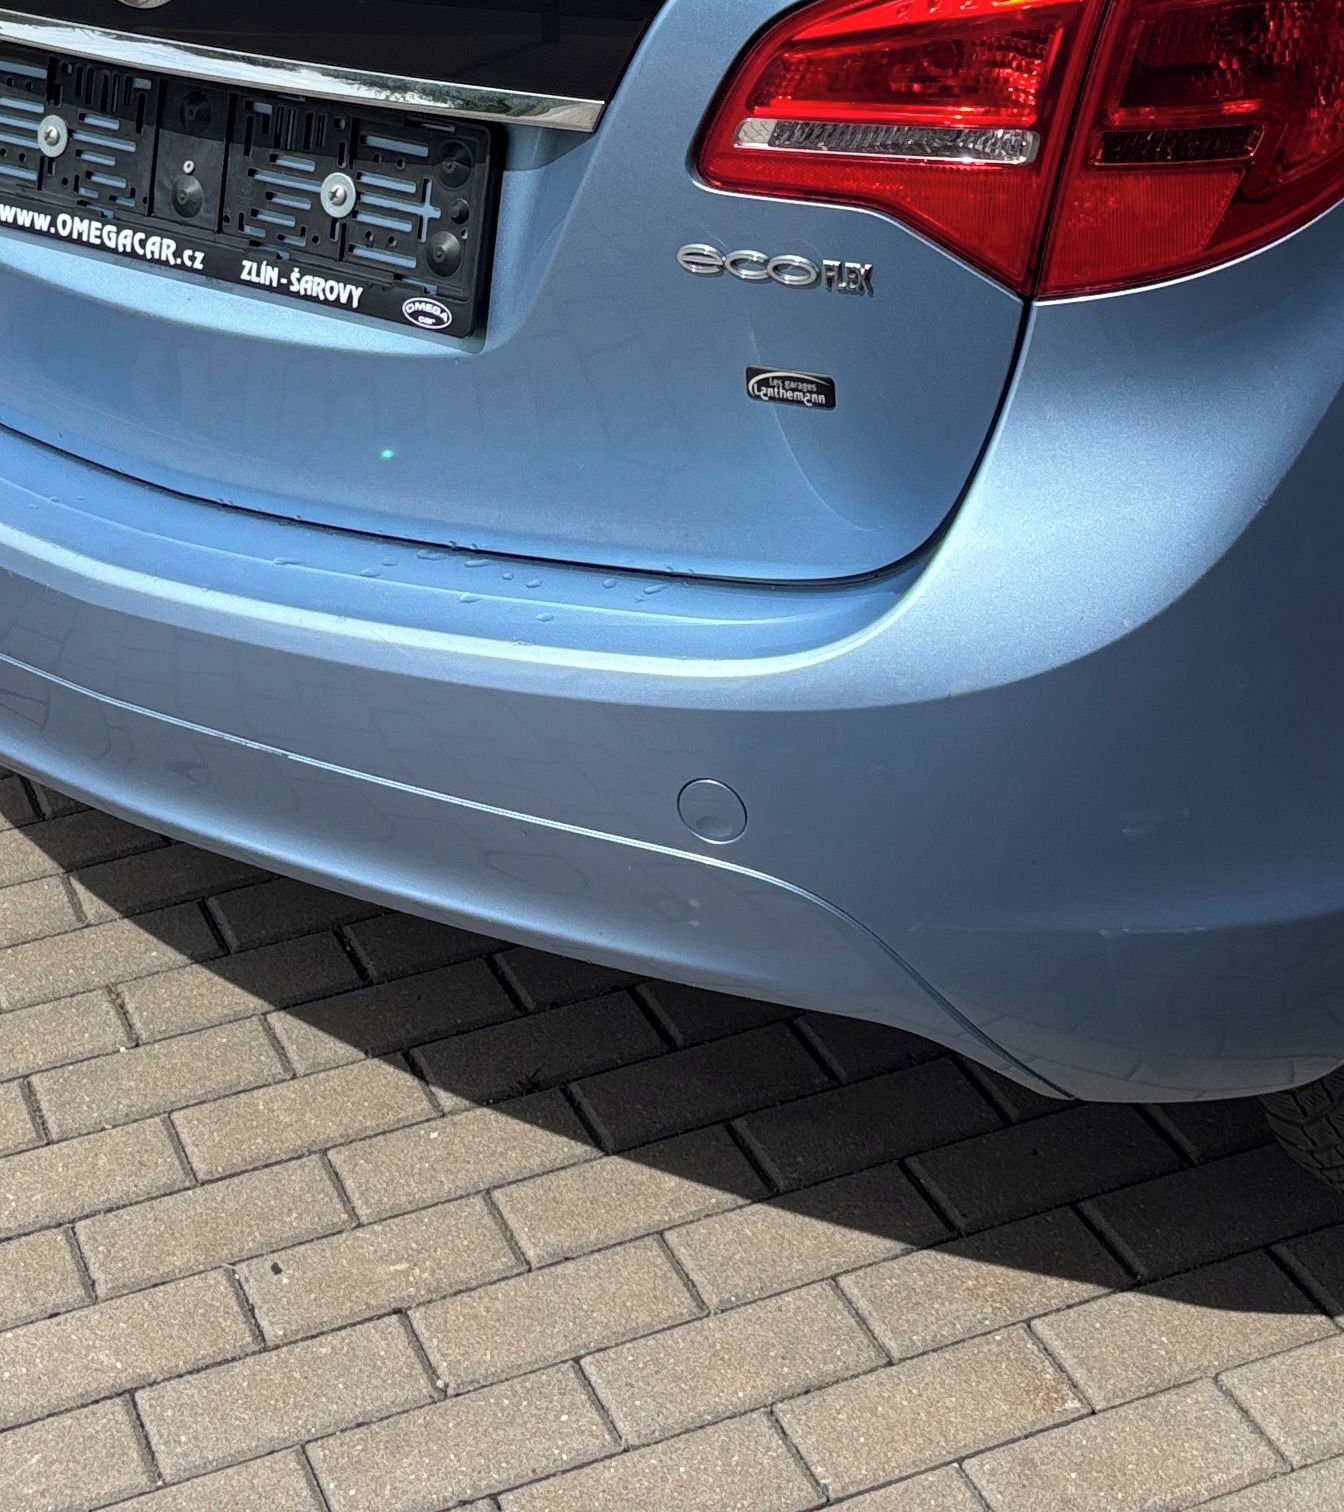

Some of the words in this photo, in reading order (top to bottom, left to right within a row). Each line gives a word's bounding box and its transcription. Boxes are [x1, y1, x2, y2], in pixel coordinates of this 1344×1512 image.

[405, 302, 449, 323] OMEGA
[417, 315, 436, 325] car
[769, 376, 783, 388] Les
[784, 379, 817, 392] garages
[753, 383, 826, 406] Lanthemann
